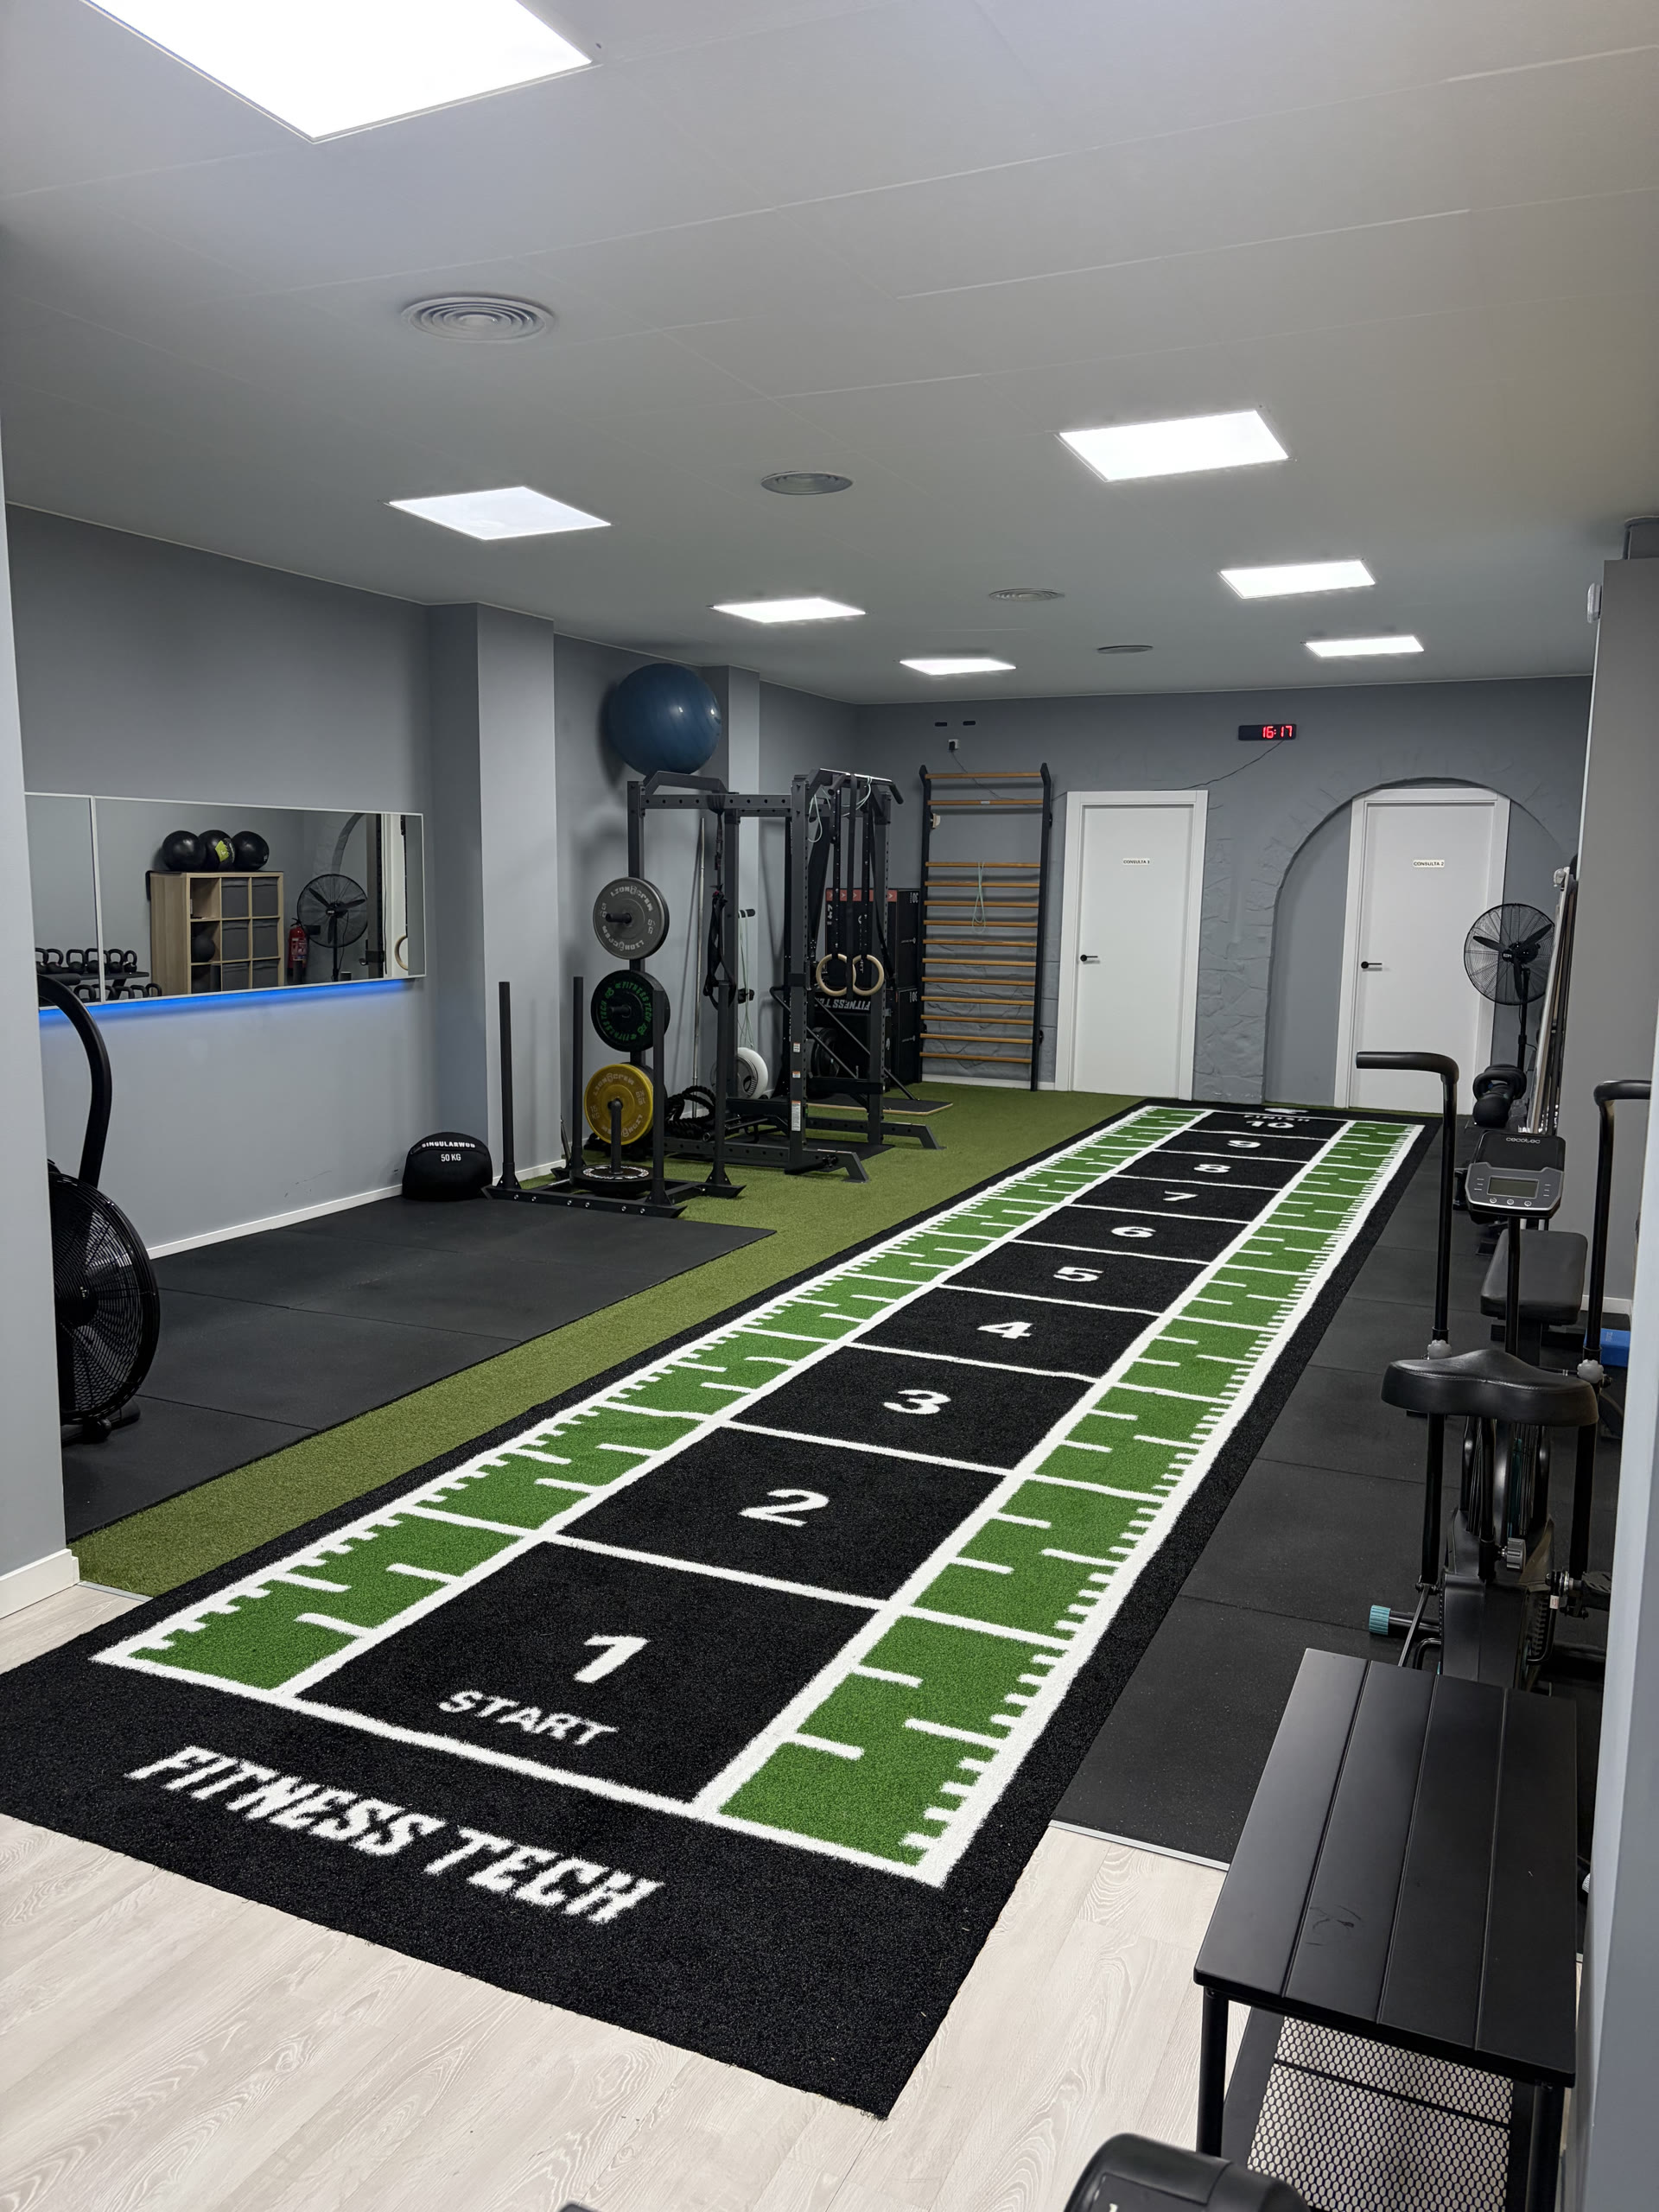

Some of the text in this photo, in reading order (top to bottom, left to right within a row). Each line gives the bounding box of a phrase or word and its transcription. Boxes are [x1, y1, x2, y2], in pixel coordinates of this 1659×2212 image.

[1262, 725, 1293, 740] 16:17
[1246, 1121, 1294, 1129] 10
[1227, 1140, 1262, 1148] 9
[441, 1154, 450, 1162] 50
[1194, 1164, 1231, 1173] 8
[1163, 1191, 1198, 1202] 7
[1111, 1226, 1157, 1238] 6
[1053, 1267, 1104, 1282] 5
[977, 1320, 1033, 1339] 4
[882, 1389, 951, 1415] 3
[738, 1488, 830, 1528] 2
[574, 1634, 651, 1684] 1
[438, 1689, 619, 1745] START
[124, 1745, 665, 1924] FITNESS TECH
